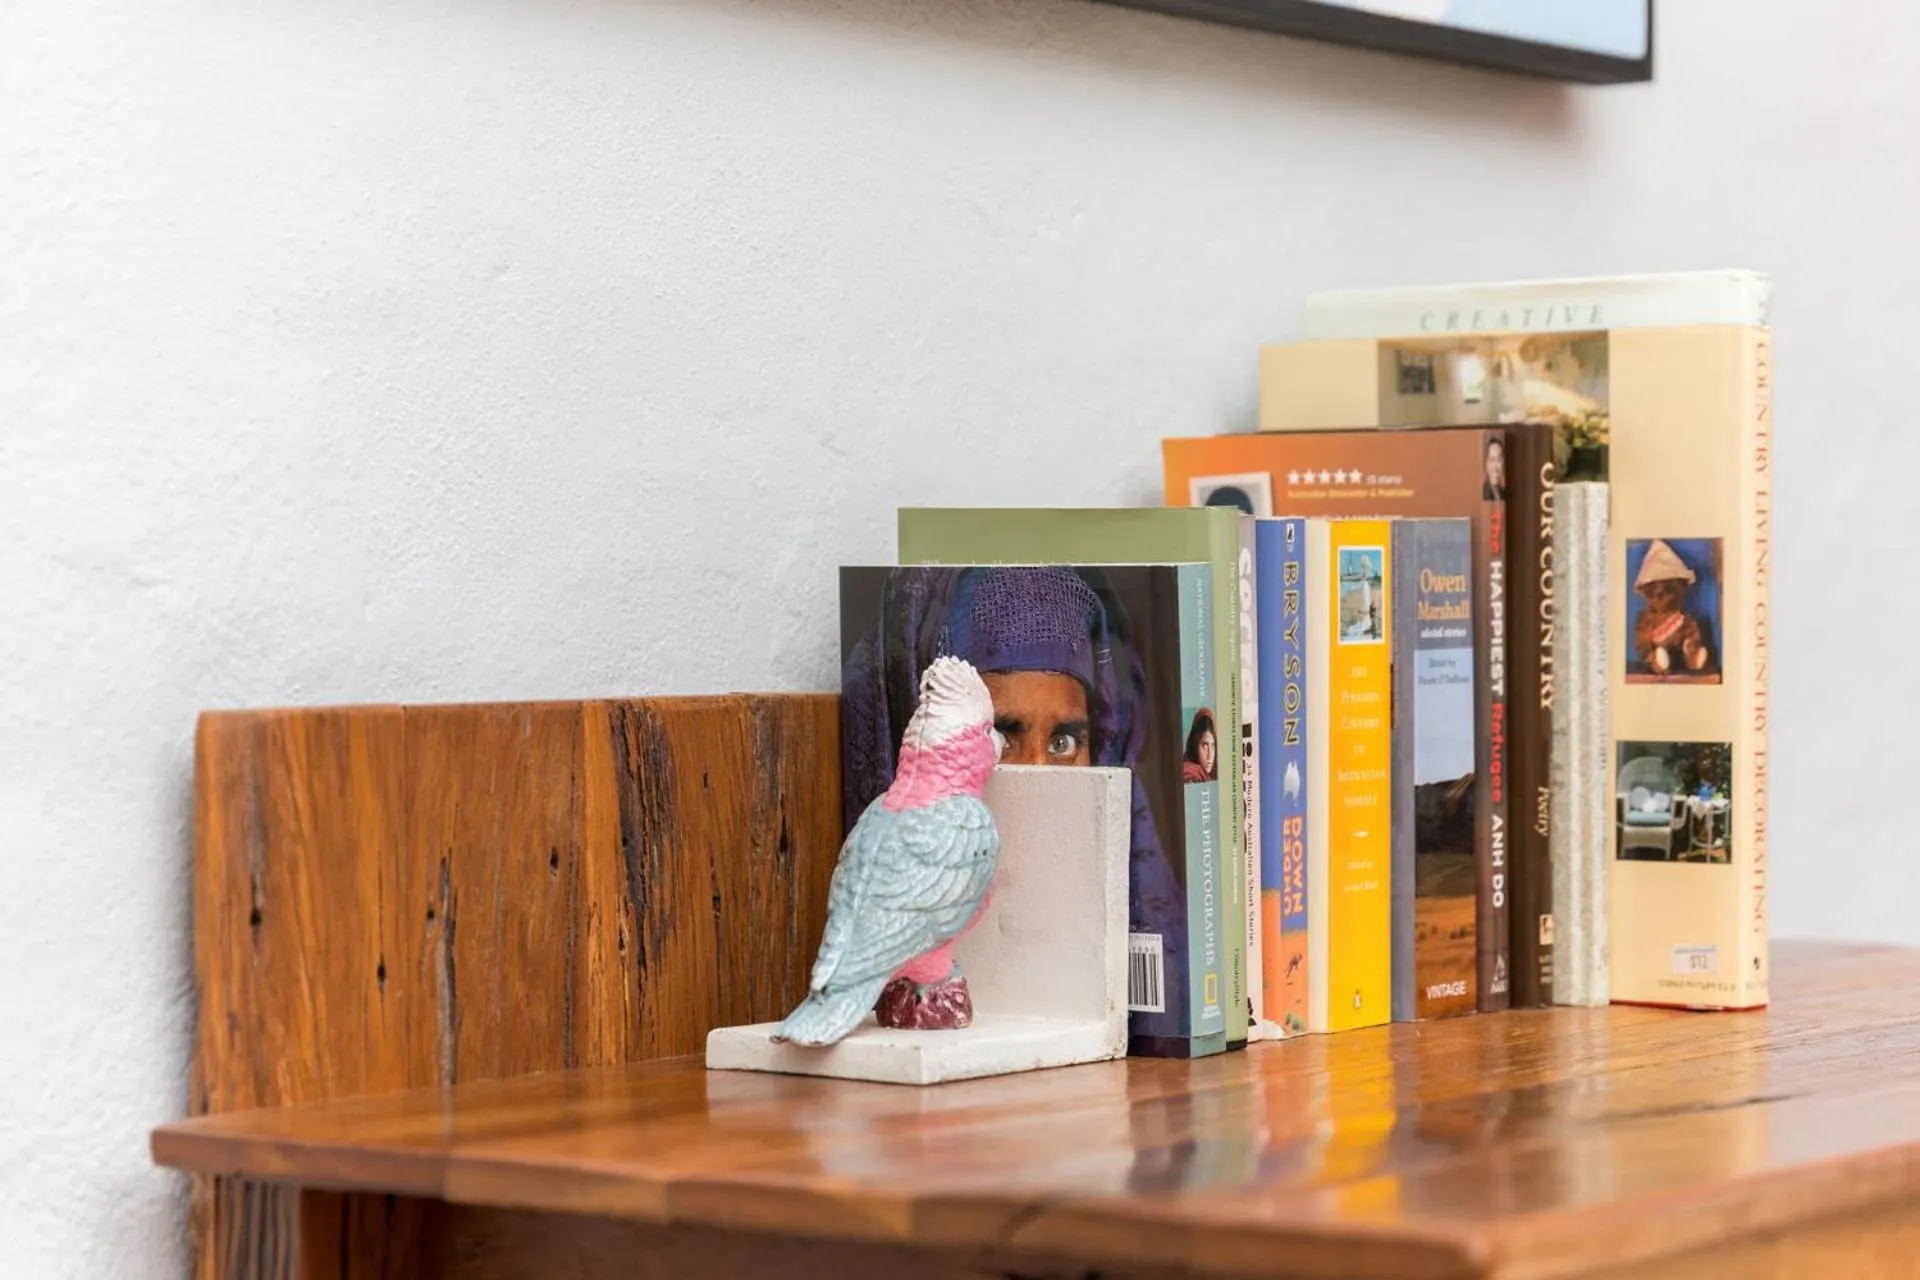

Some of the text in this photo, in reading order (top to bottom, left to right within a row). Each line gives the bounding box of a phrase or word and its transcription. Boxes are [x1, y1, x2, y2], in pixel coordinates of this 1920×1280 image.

[1419, 303, 1607, 331] CREATIVE
[1755, 342, 1769, 475] COUNTRY
[1420, 568, 1467, 593] Owen
[1540, 461, 1555, 711] OUR COUNTRY
[1754, 490, 1768, 588] LIVING
[1284, 562, 1301, 745] BRYSON
[1417, 600, 1471, 620] Marshall
[1490, 511, 1504, 907] The HAPPIEST Refugee ANH DO
[1754, 601, 1768, 735] COUNTRY
[1534, 786, 1551, 837] Poetry
[1753, 751, 1767, 934] DECORATING
[1201, 789, 1216, 966] THE PHOTOGRAPHS
[1247, 879, 1255, 907] Short
[1282, 817, 1292, 917] UNDER
[1291, 815, 1304, 914] DOWN
[1248, 911, 1256, 947] Stories
[1425, 980, 1467, 1001] VINTAGE
